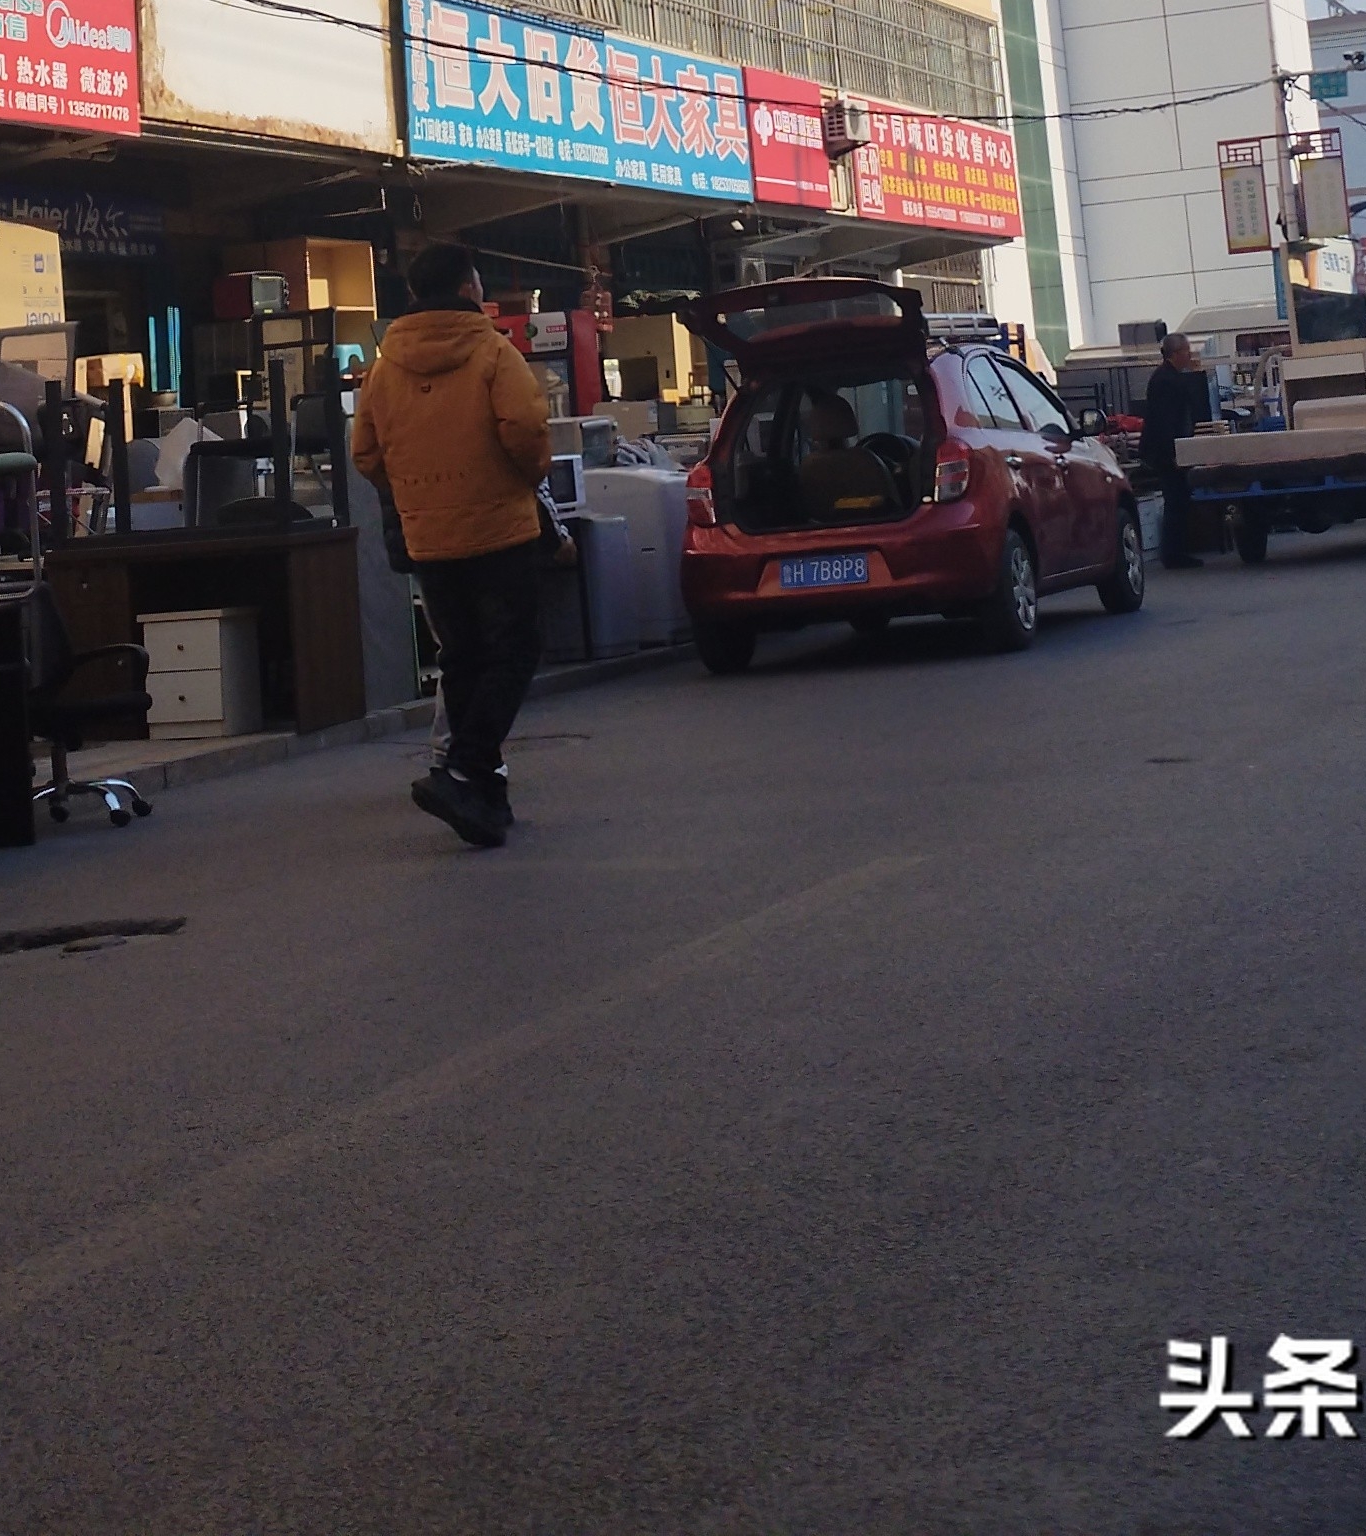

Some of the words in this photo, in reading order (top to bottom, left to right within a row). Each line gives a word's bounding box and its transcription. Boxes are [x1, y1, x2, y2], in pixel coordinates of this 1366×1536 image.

[17, 56, 68, 90] 热水器
[80, 66, 128, 97] 微波炉
[428, 2, 605, 134] 恒大旧货
[606, 47, 748, 164] 恒大家具
